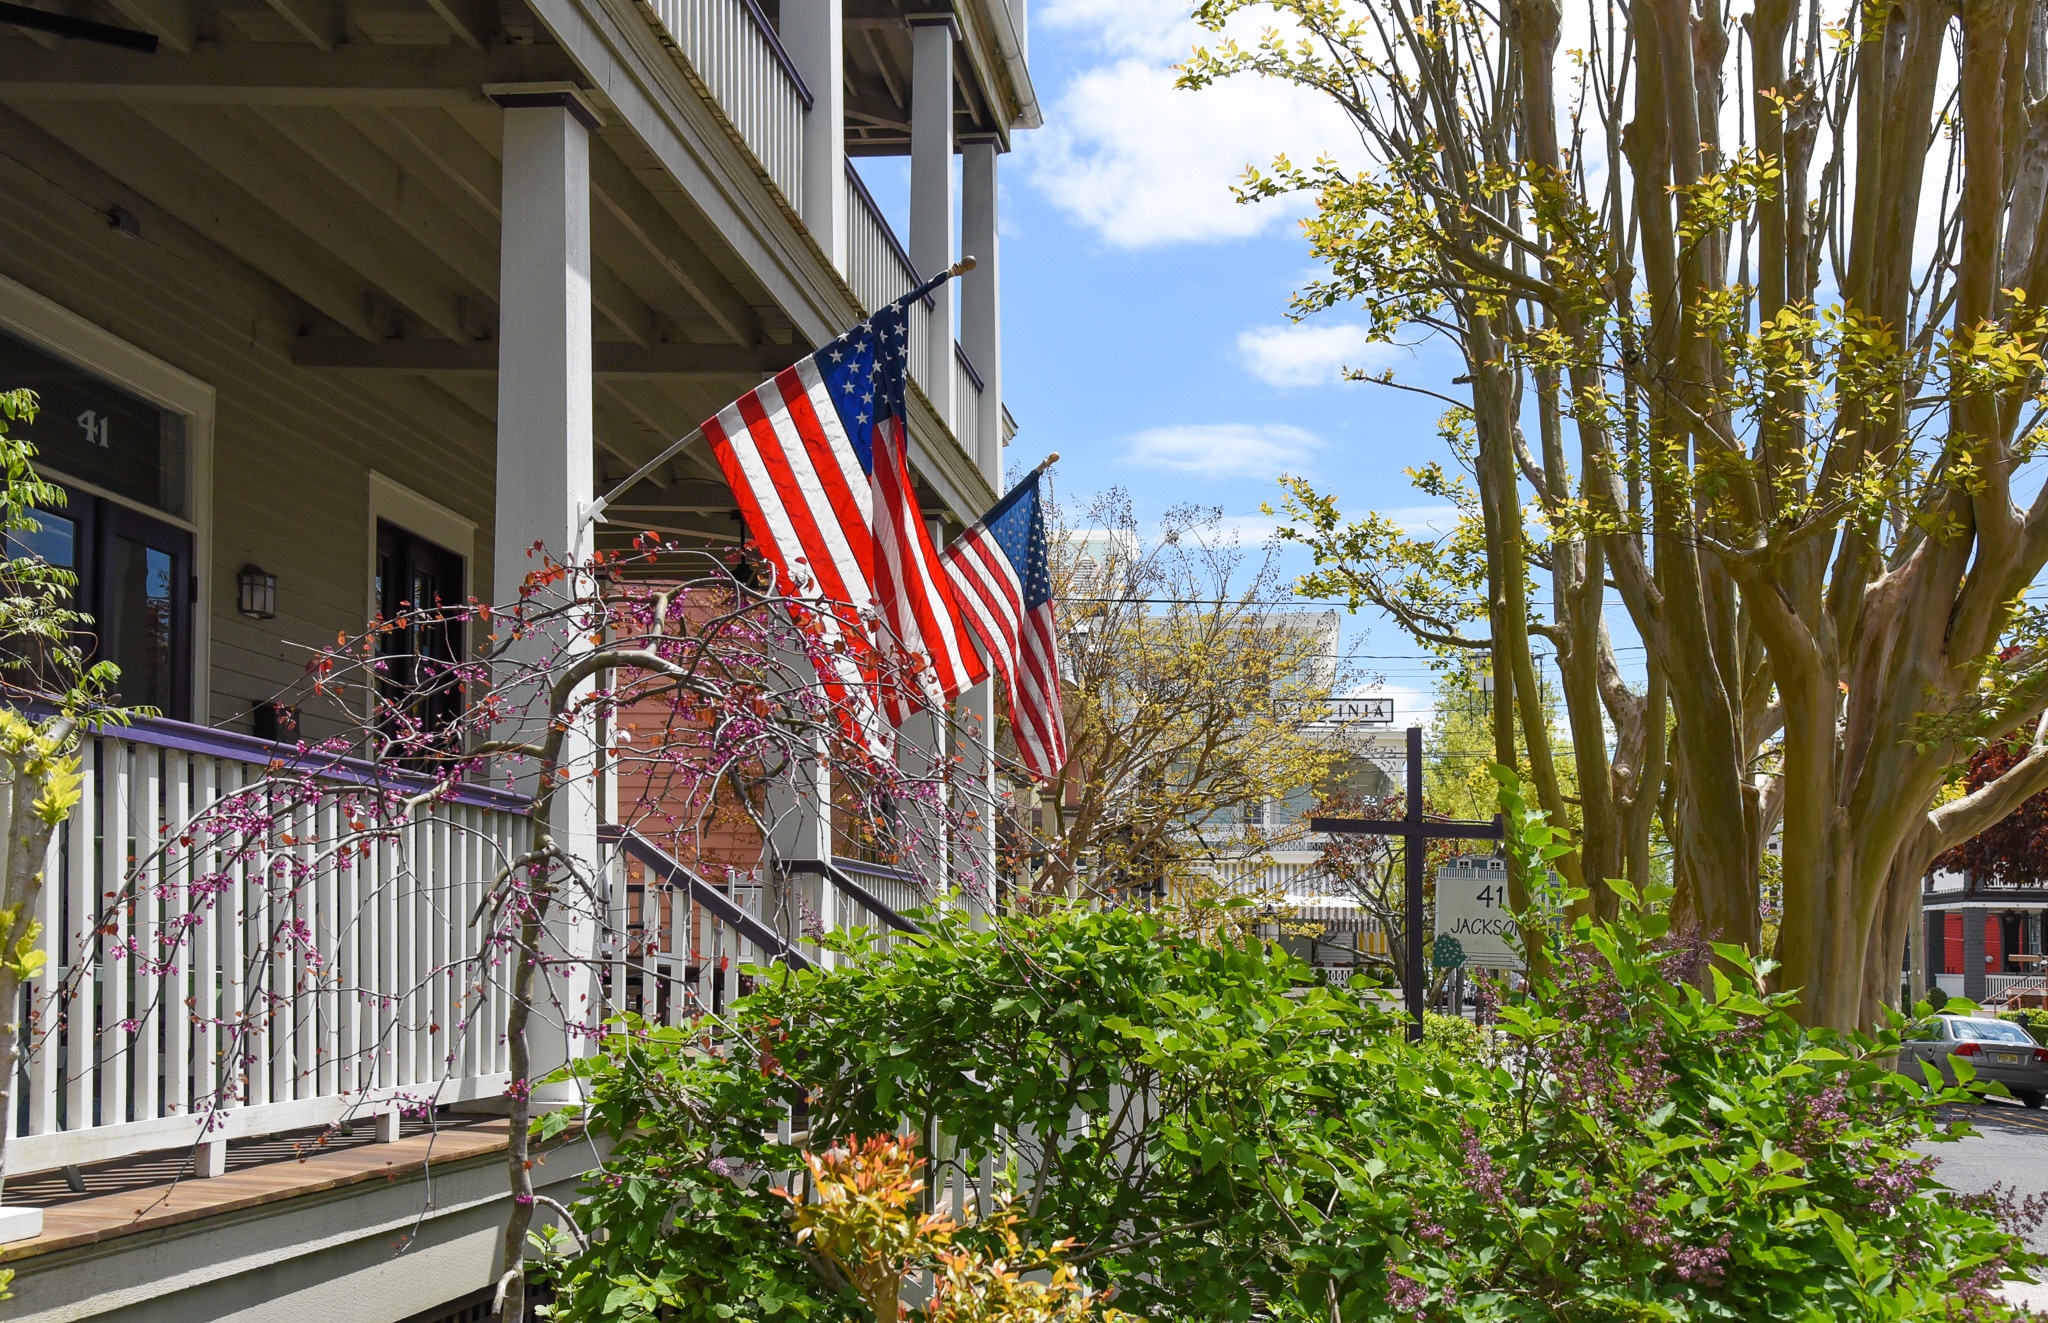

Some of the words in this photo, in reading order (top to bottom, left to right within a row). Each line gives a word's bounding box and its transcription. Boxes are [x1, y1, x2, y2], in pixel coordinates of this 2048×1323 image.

[76, 410, 109, 449] 41
[1280, 703, 1384, 718] VIGINIA
[1476, 884, 1504, 909] 41
